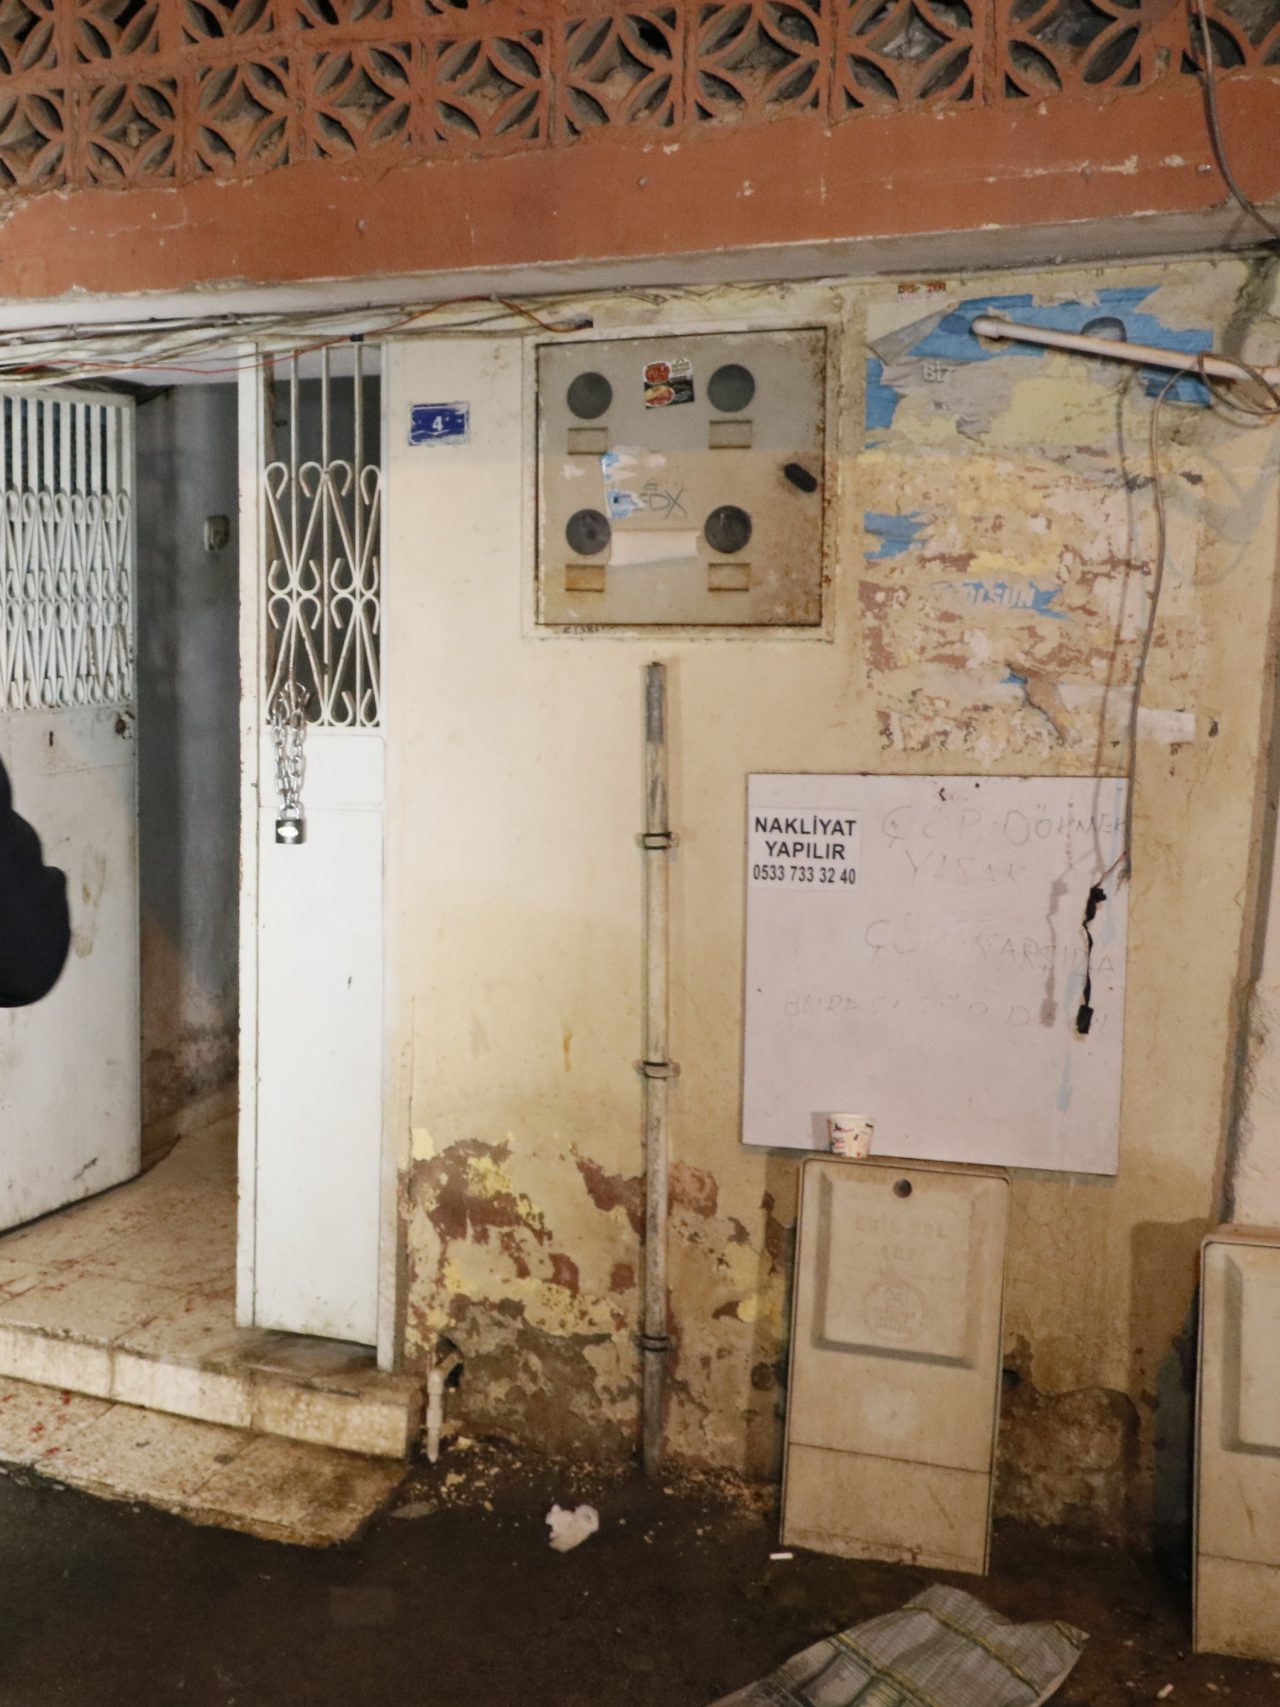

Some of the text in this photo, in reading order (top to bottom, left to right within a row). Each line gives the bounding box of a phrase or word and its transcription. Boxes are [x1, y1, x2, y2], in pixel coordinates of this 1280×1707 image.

[432, 415, 444, 431] 4
[755, 814, 857, 837] NAKLİYAT
[765, 840, 846, 861] YAPILIR
[753, 864, 856, 885] 0533 733 32 40
